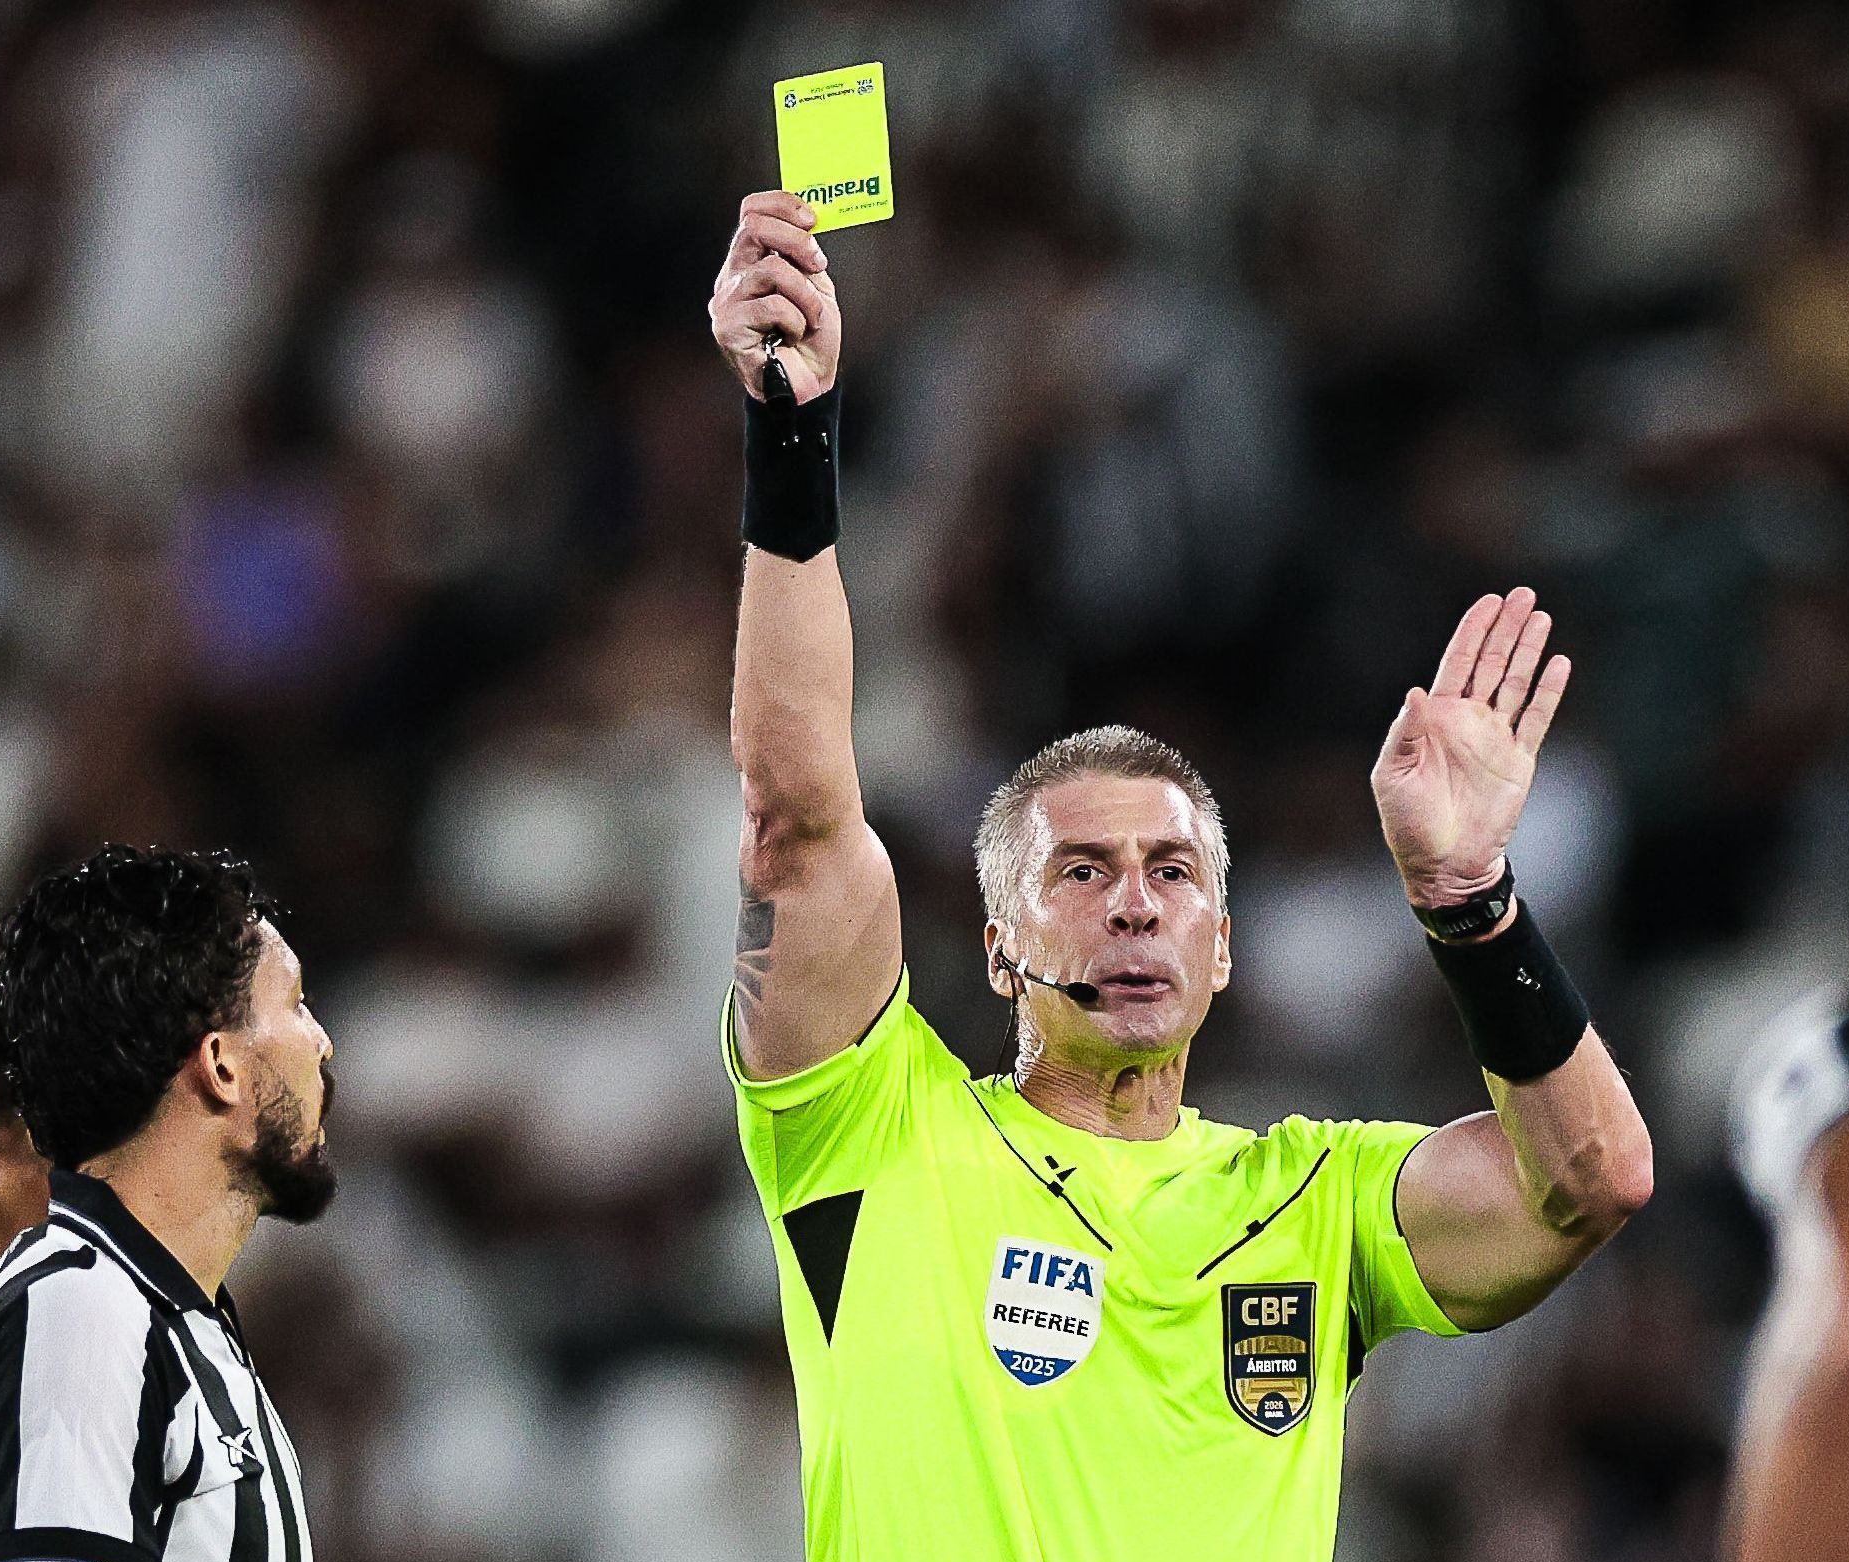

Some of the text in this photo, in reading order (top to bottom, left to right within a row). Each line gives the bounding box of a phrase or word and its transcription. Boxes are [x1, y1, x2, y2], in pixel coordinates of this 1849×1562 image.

[1001, 1246, 1094, 1298] FIFA
[992, 1303, 1091, 1338] REFEREE
[1241, 1296, 1299, 1326] CBF
[1010, 1354, 1056, 1377] 2025
[1246, 1357, 1297, 1373] ÁRBITRO
